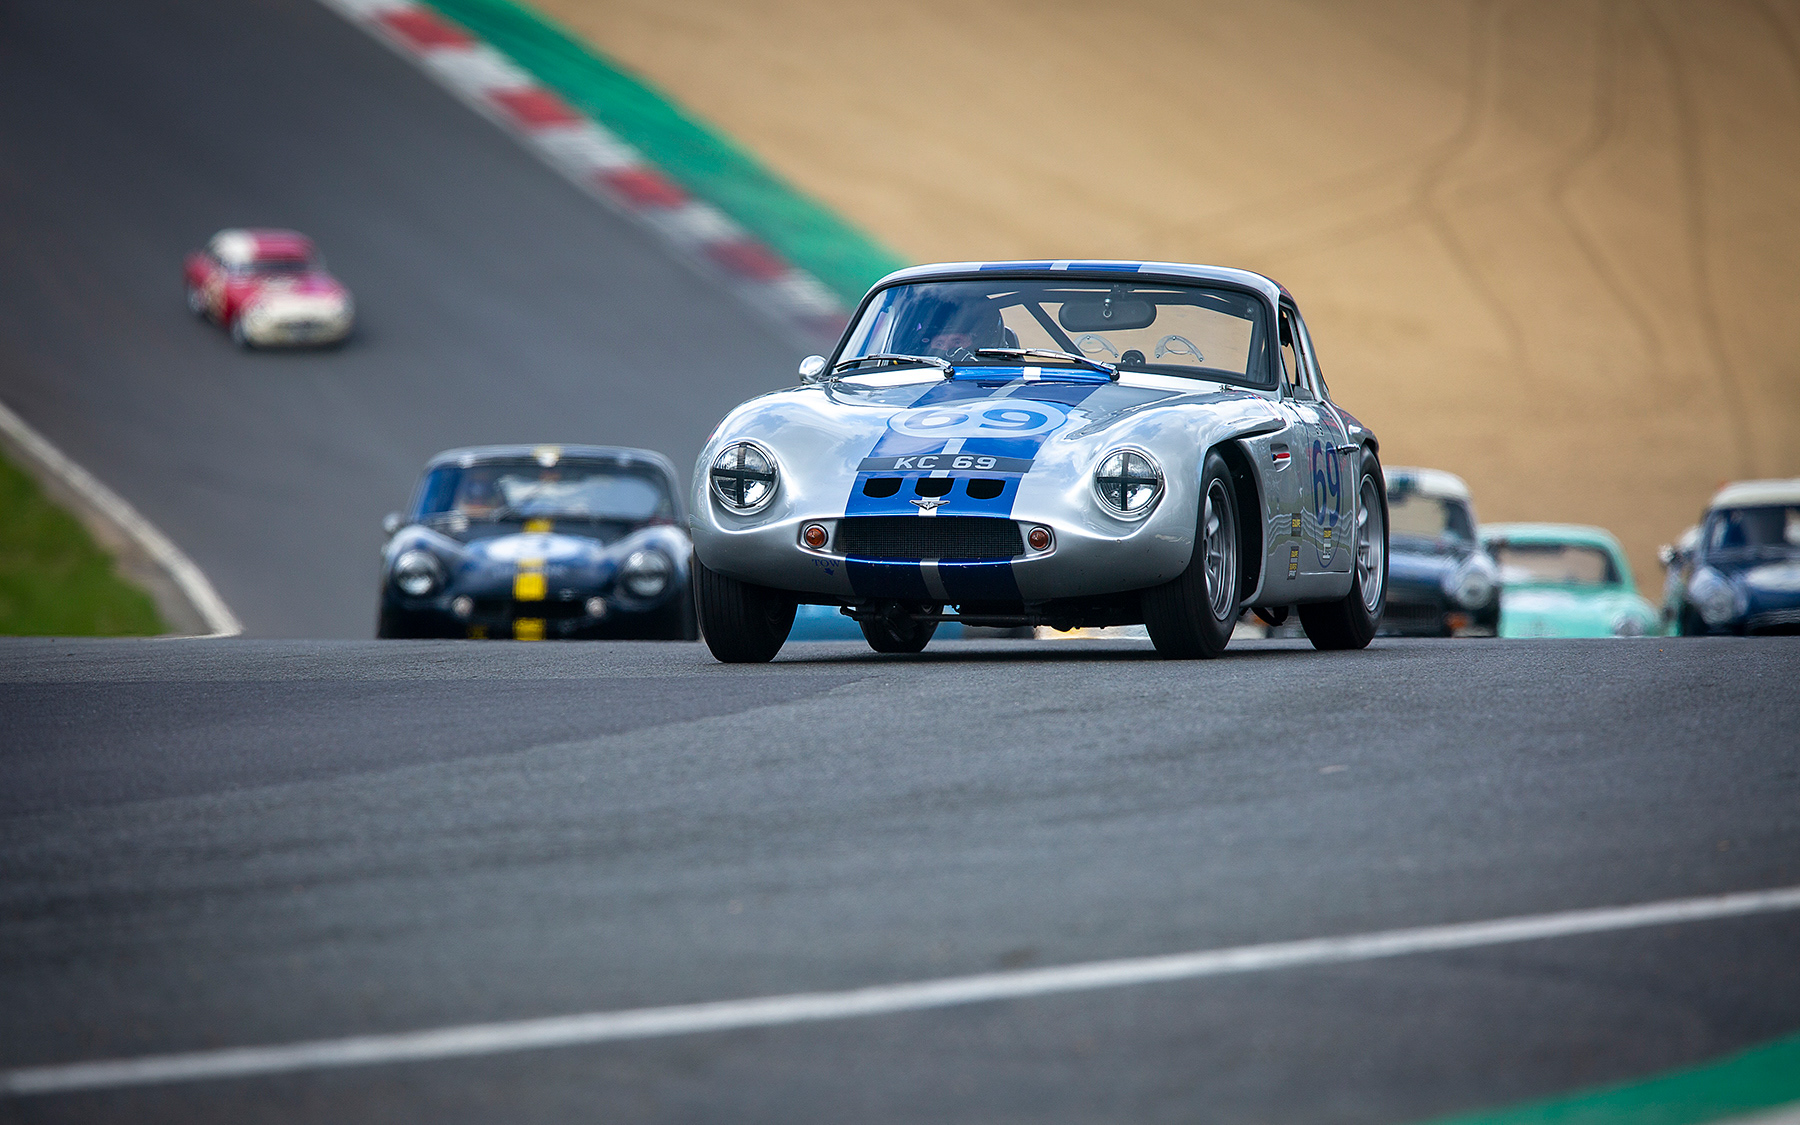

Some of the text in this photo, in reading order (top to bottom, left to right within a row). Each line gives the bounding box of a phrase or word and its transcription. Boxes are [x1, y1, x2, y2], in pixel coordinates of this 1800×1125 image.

[903, 405, 1049, 431] 69
[893, 455, 998, 470] KC 69
[1312, 439, 1341, 527] 69
[811, 558, 841, 568] TOW
